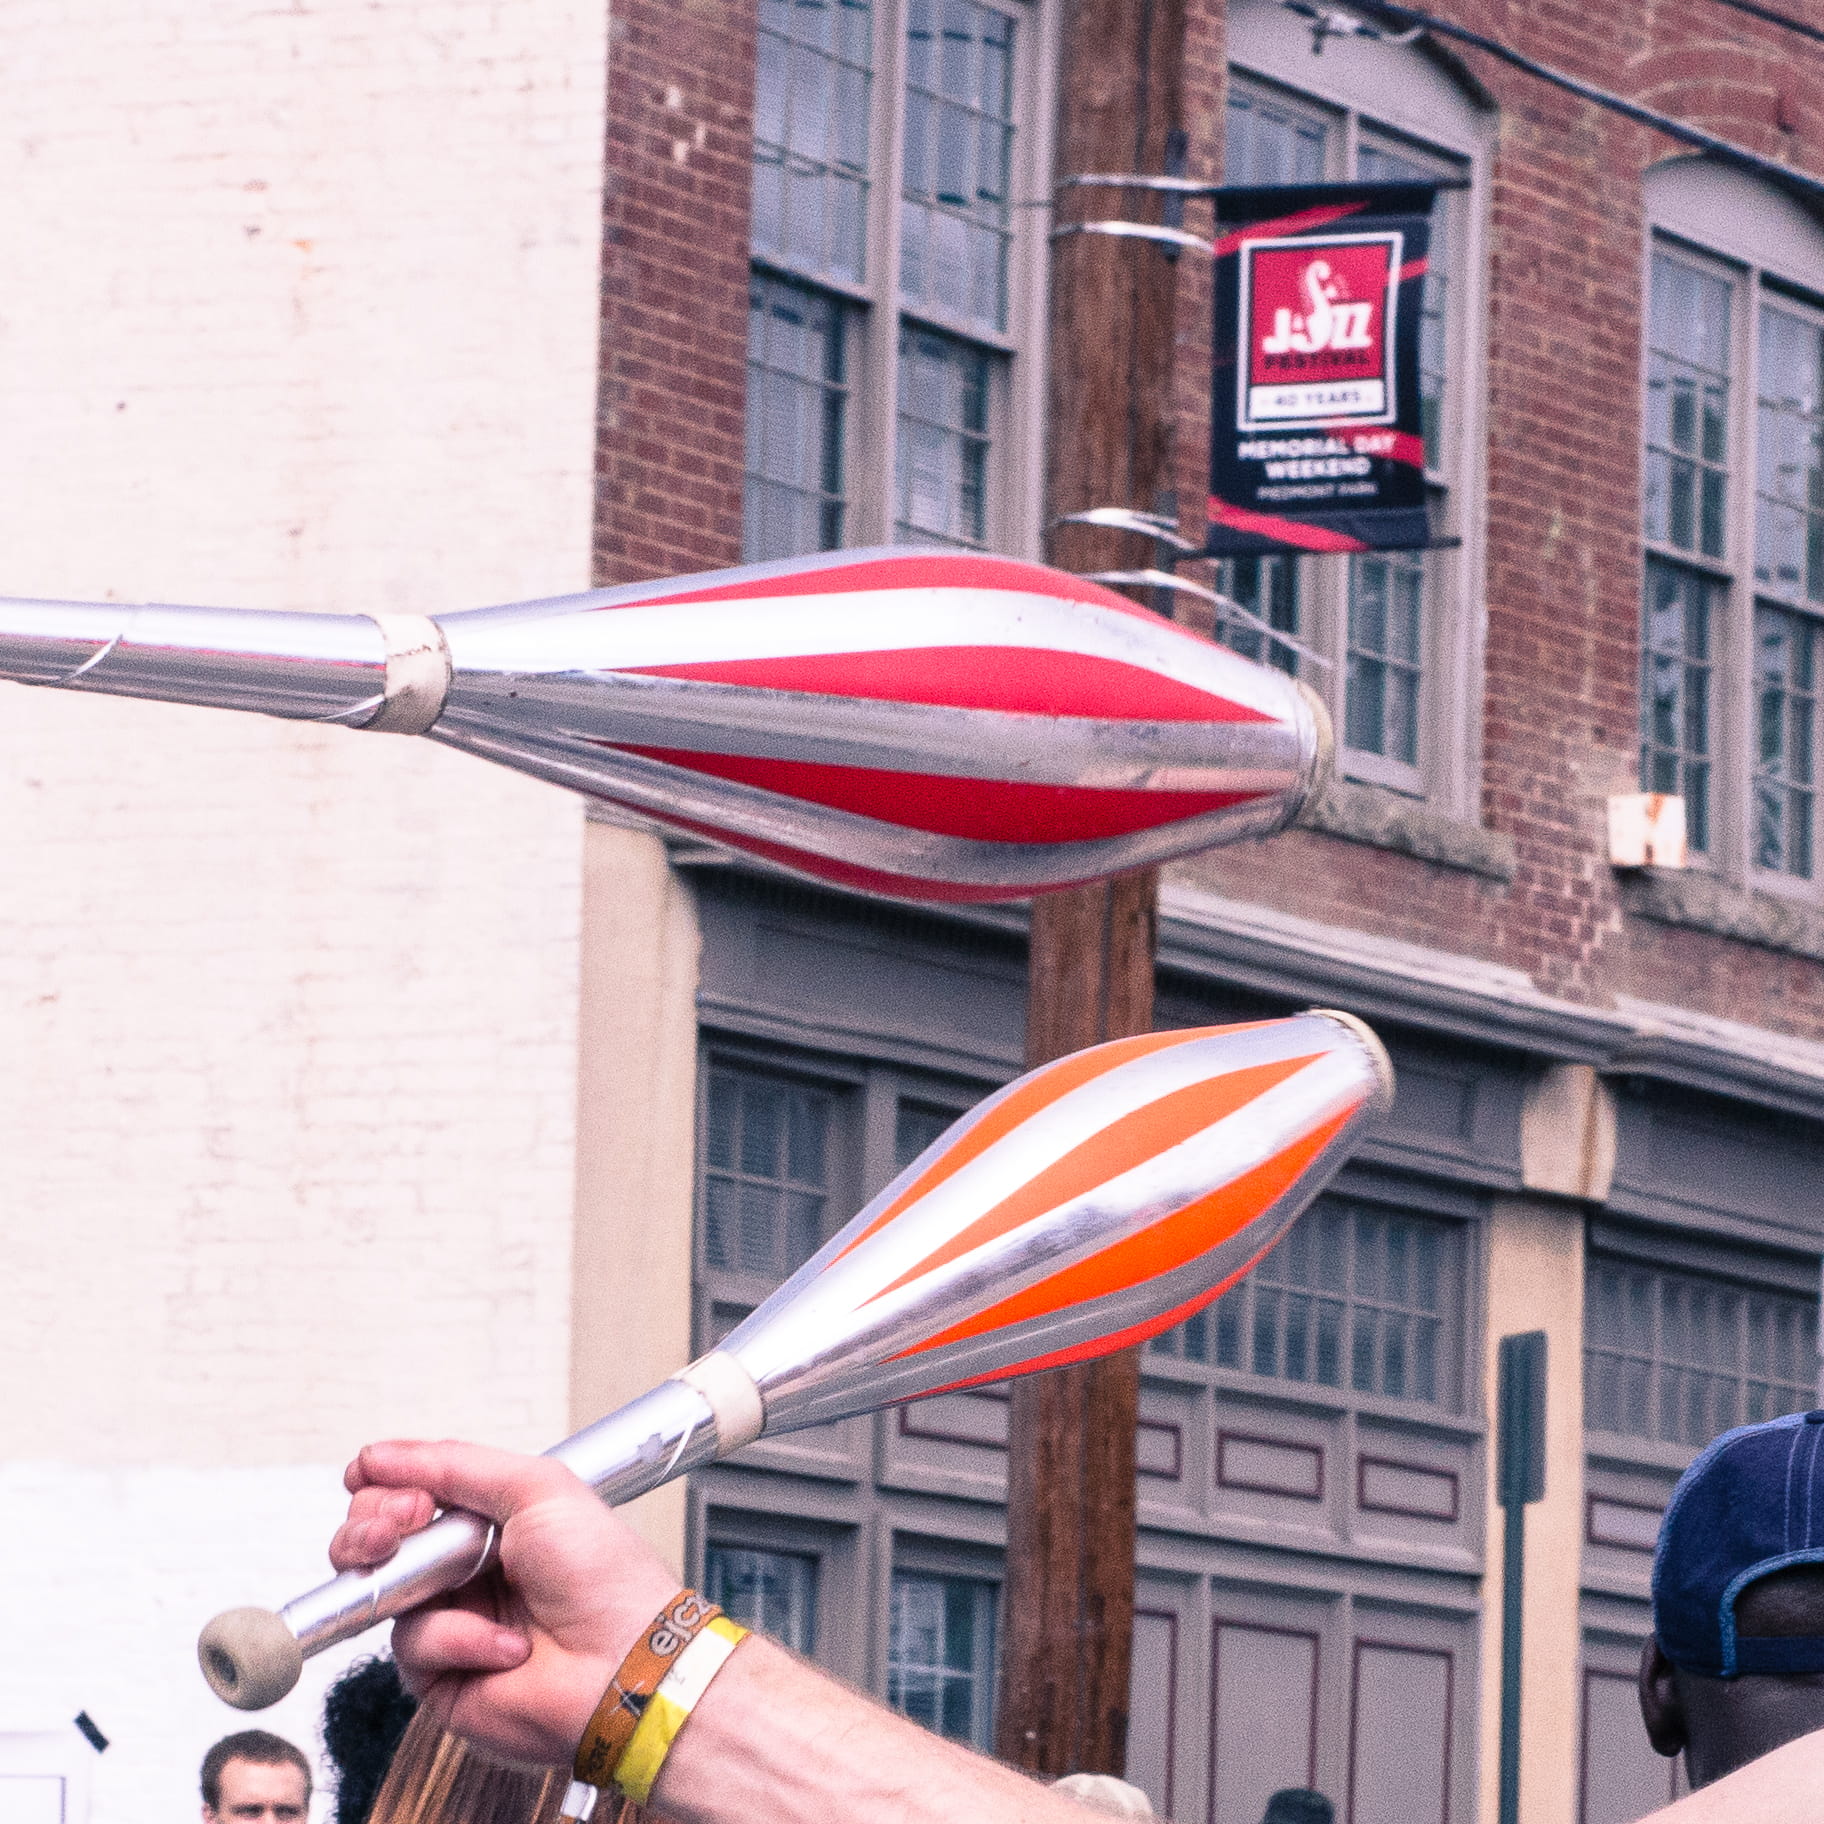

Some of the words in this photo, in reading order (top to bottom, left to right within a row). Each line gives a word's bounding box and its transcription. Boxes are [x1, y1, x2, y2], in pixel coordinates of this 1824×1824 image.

[1264, 350, 1370, 369] FESTIVAL
[1306, 390, 1361, 405] YEARS
[1239, 437, 1349, 459] MEMORIAL
[1354, 433, 1396, 454] DAY
[1266, 457, 1371, 478] WEEKEND
